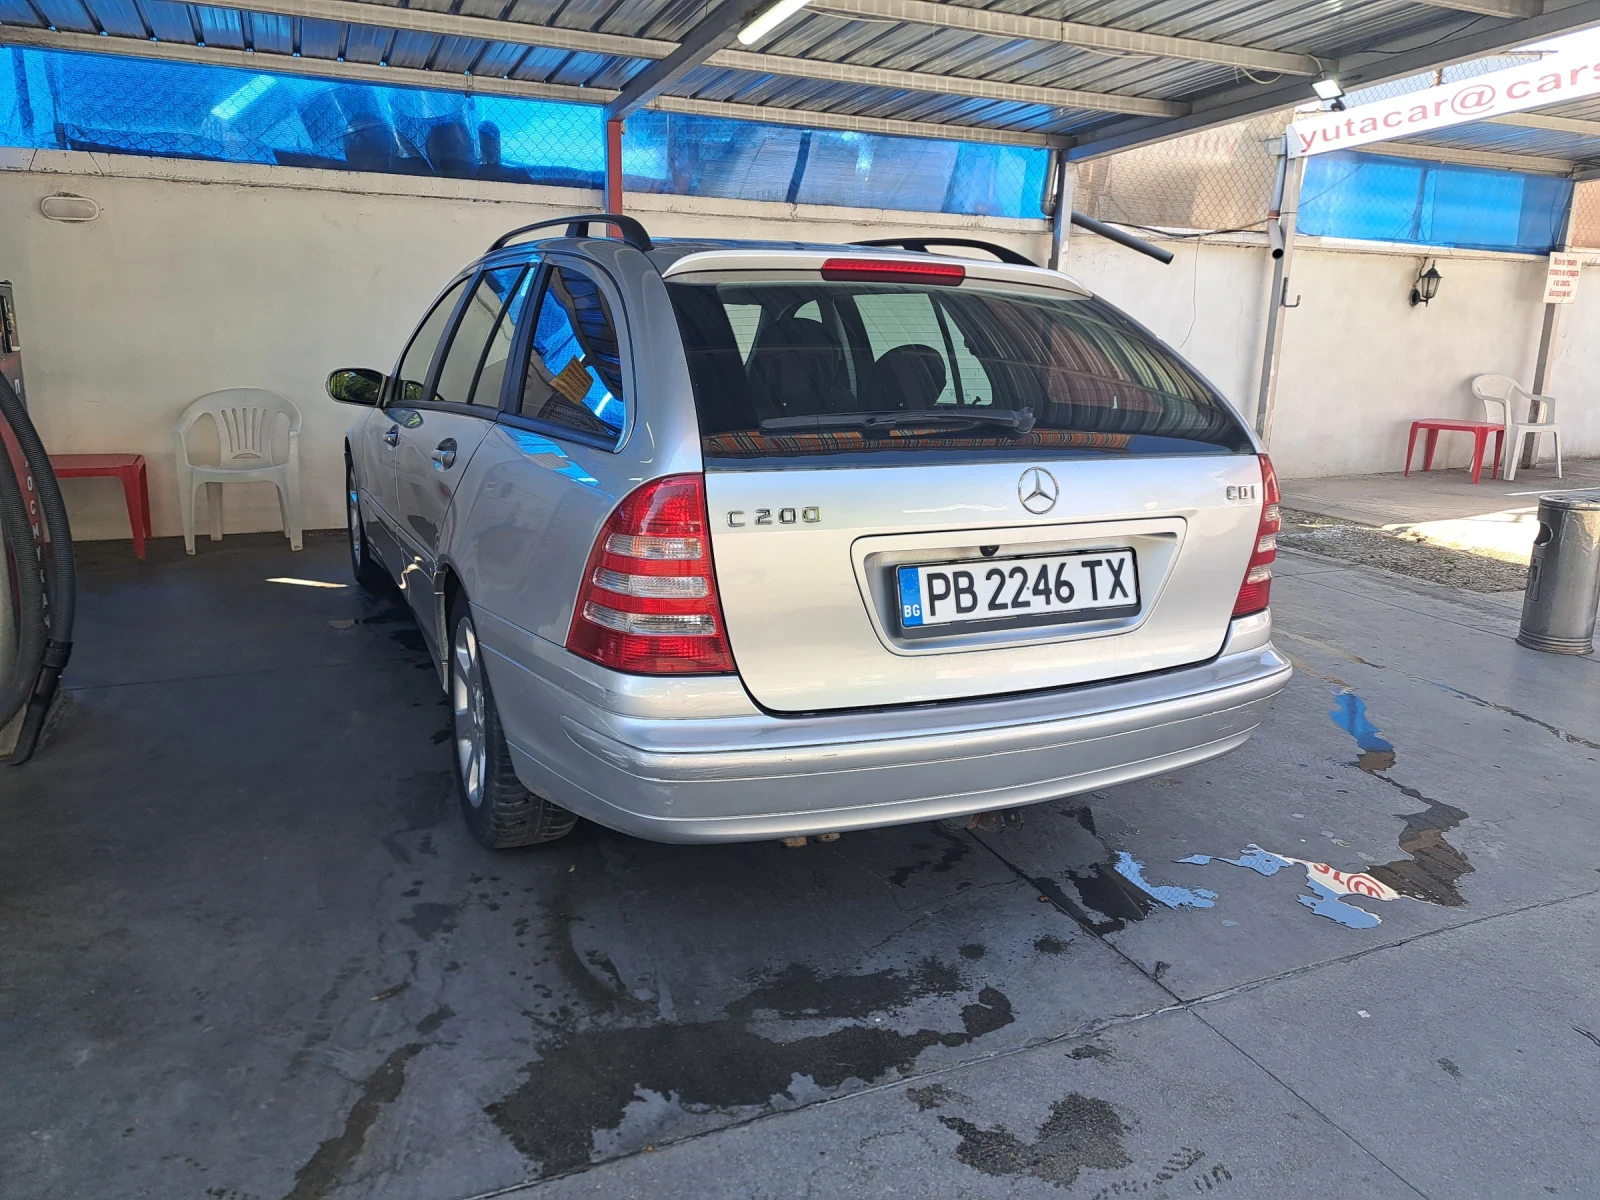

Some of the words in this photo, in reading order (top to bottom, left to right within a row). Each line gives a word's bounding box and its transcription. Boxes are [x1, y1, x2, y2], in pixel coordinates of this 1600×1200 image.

[1226, 485, 1257, 500] CDI
[926, 570, 978, 616] PB
[985, 562, 1075, 611] 2246
[1081, 557, 1130, 601] TX
[903, 603, 921, 618] BG
